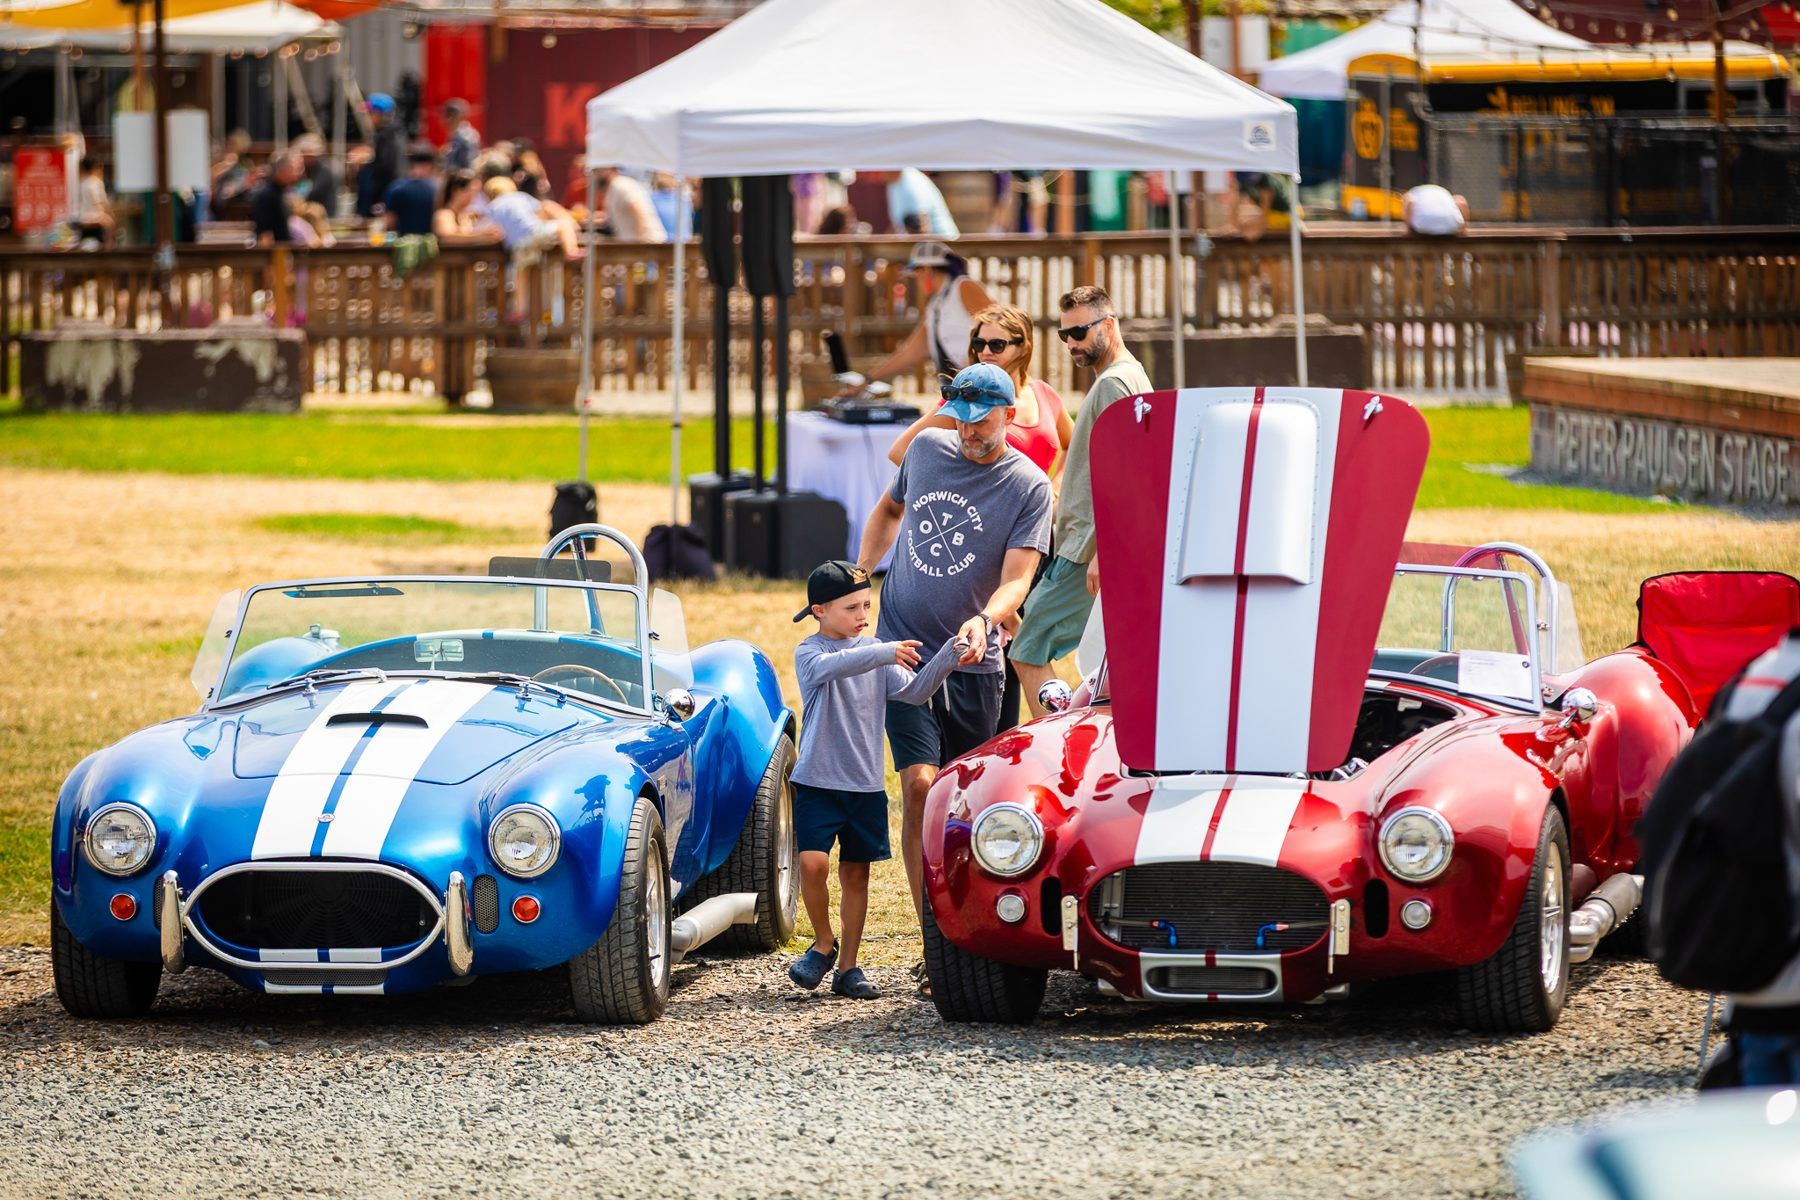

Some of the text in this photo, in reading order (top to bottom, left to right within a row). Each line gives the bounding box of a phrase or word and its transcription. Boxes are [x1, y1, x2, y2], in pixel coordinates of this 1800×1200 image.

[1553, 411, 1791, 503] PETER PAULSEN STAGE
[912, 491, 984, 532] NORWICH CITY
[941, 512, 953, 526] T
[919, 520, 933, 534] O
[952, 532, 965, 546] B
[907, 530, 976, 577] FOOTBALL CLUB
[930, 543, 942, 557] C
